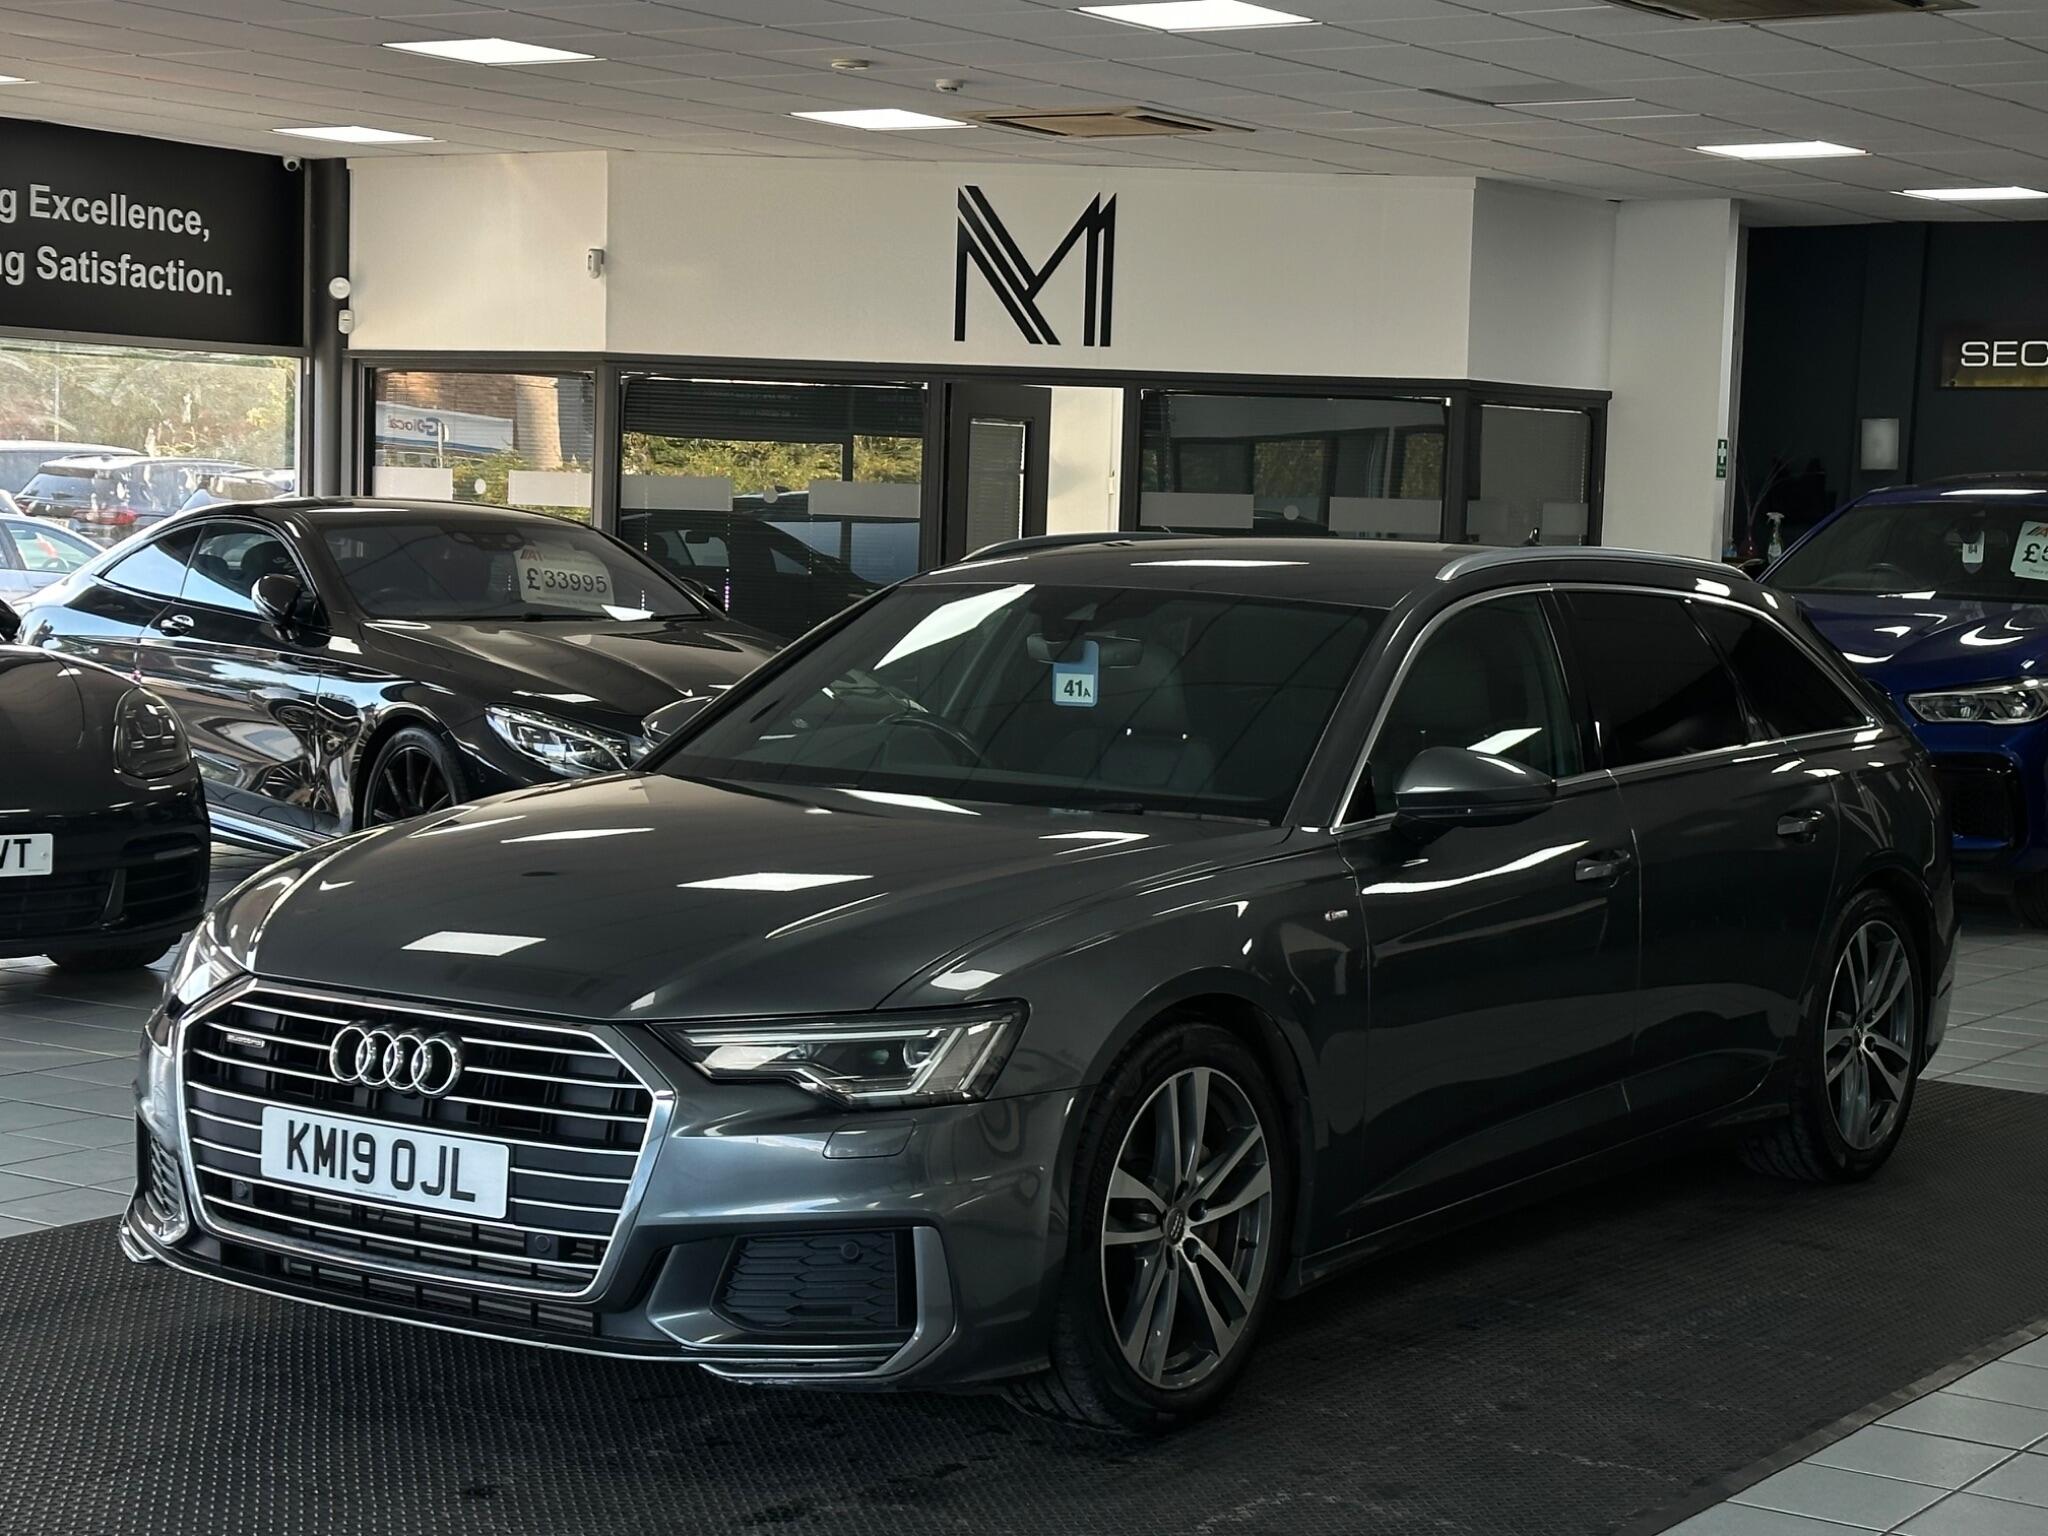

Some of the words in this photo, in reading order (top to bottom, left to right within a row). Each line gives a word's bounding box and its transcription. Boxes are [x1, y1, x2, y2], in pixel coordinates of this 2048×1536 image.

[29, 183, 210, 242] Excellence,
[0, 250, 25, 286] g
[36, 245, 233, 296] Satisfaction.
[1961, 340, 2048, 367] SEC
[526, 567, 607, 593] £33995
[1063, 679, 1091, 697] 41A
[287, 1119, 376, 1185] KM19
[391, 1138, 477, 1203] OJL
